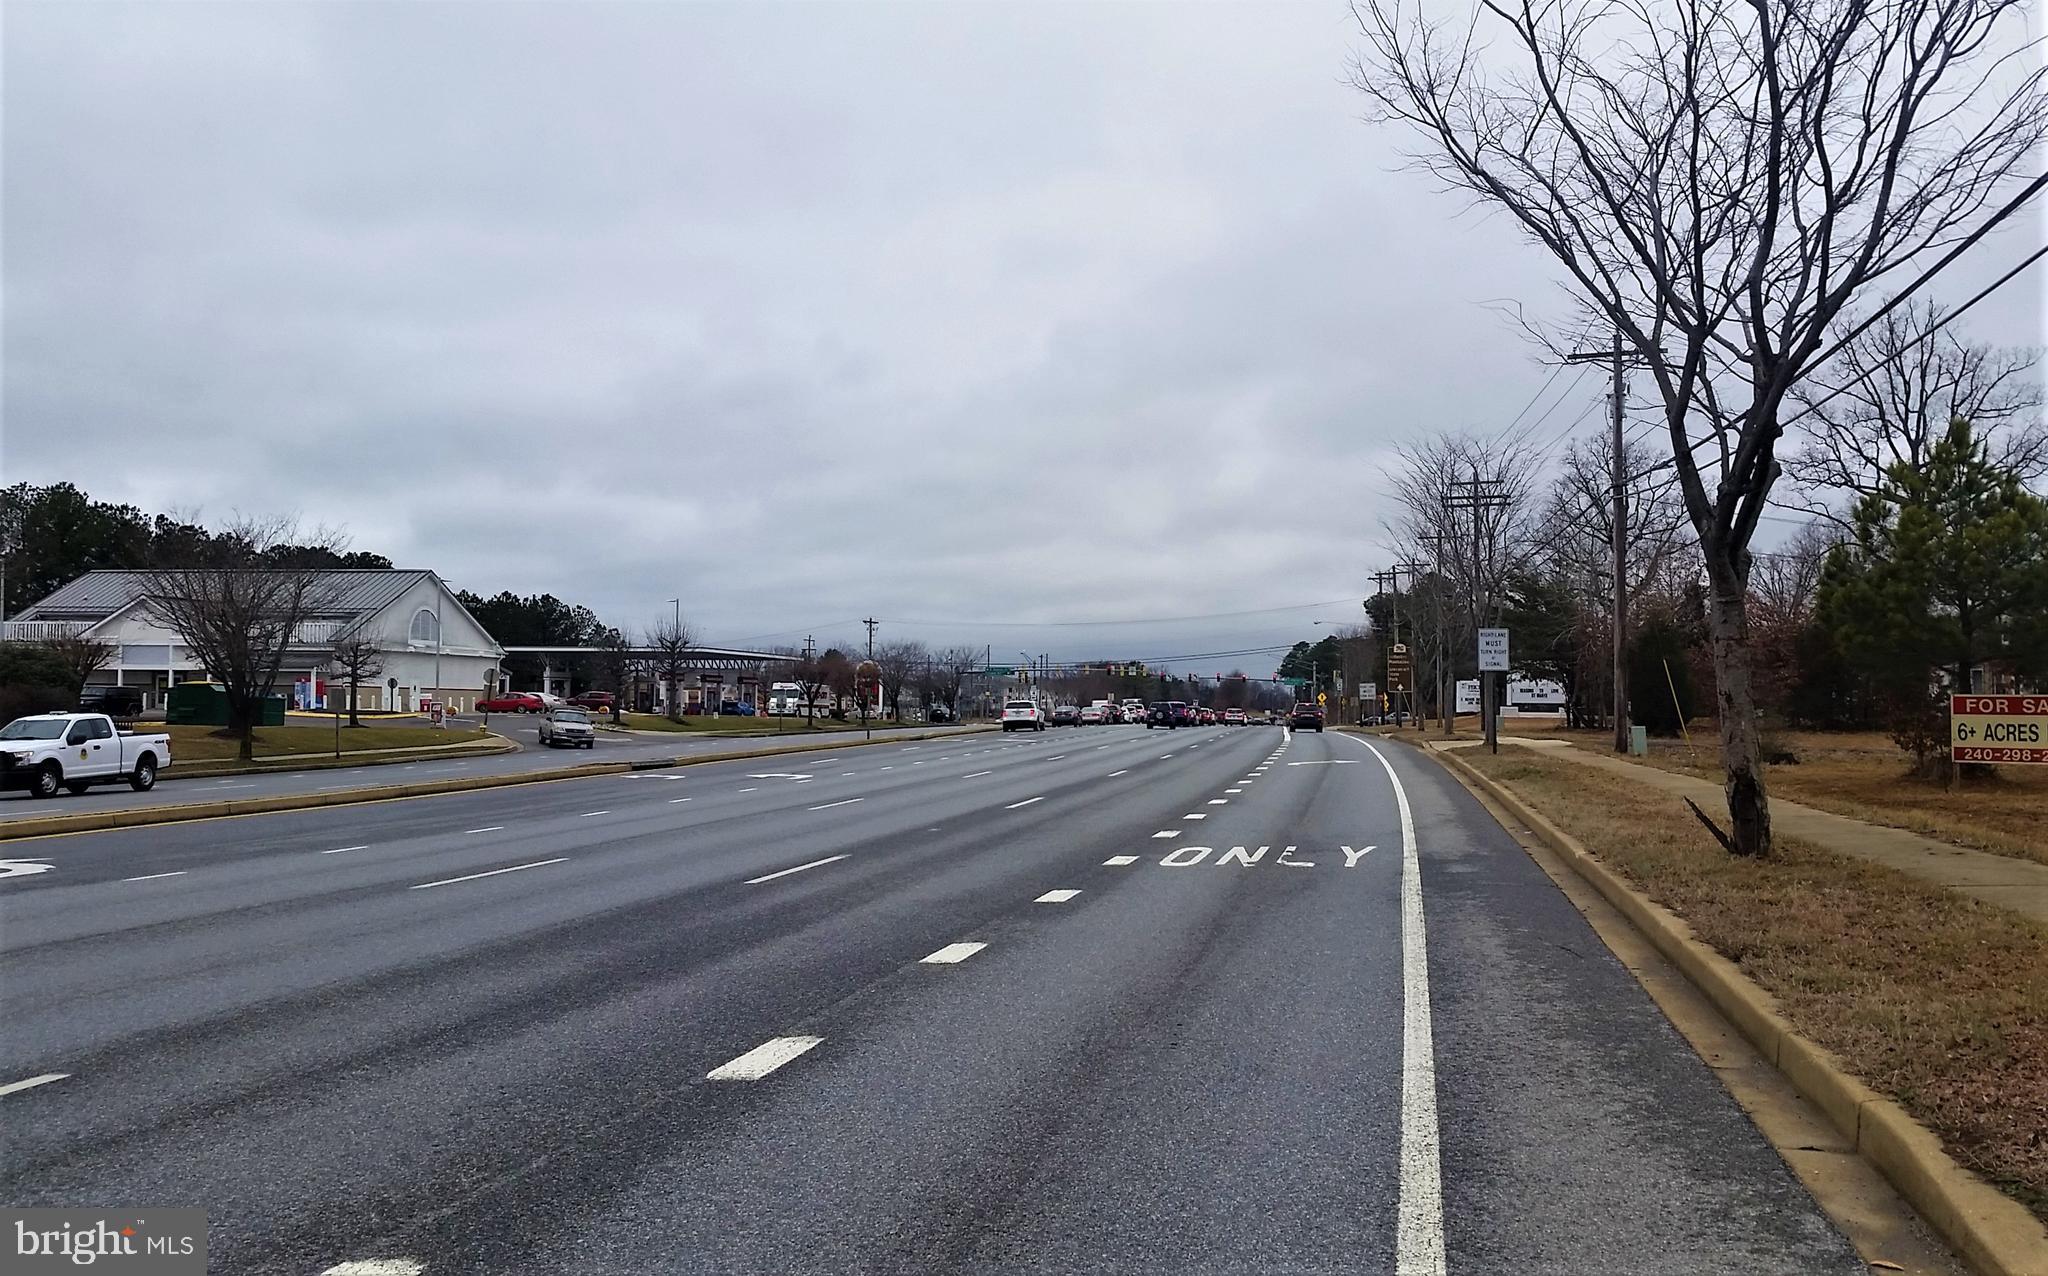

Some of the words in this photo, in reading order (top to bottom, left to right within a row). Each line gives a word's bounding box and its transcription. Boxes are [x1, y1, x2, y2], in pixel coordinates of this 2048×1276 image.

[1966, 699, 2009, 713] FOR
[1957, 722, 1977, 741] 6+
[1983, 723, 2039, 743] ACRES
[1159, 846, 1377, 867] ONLY
